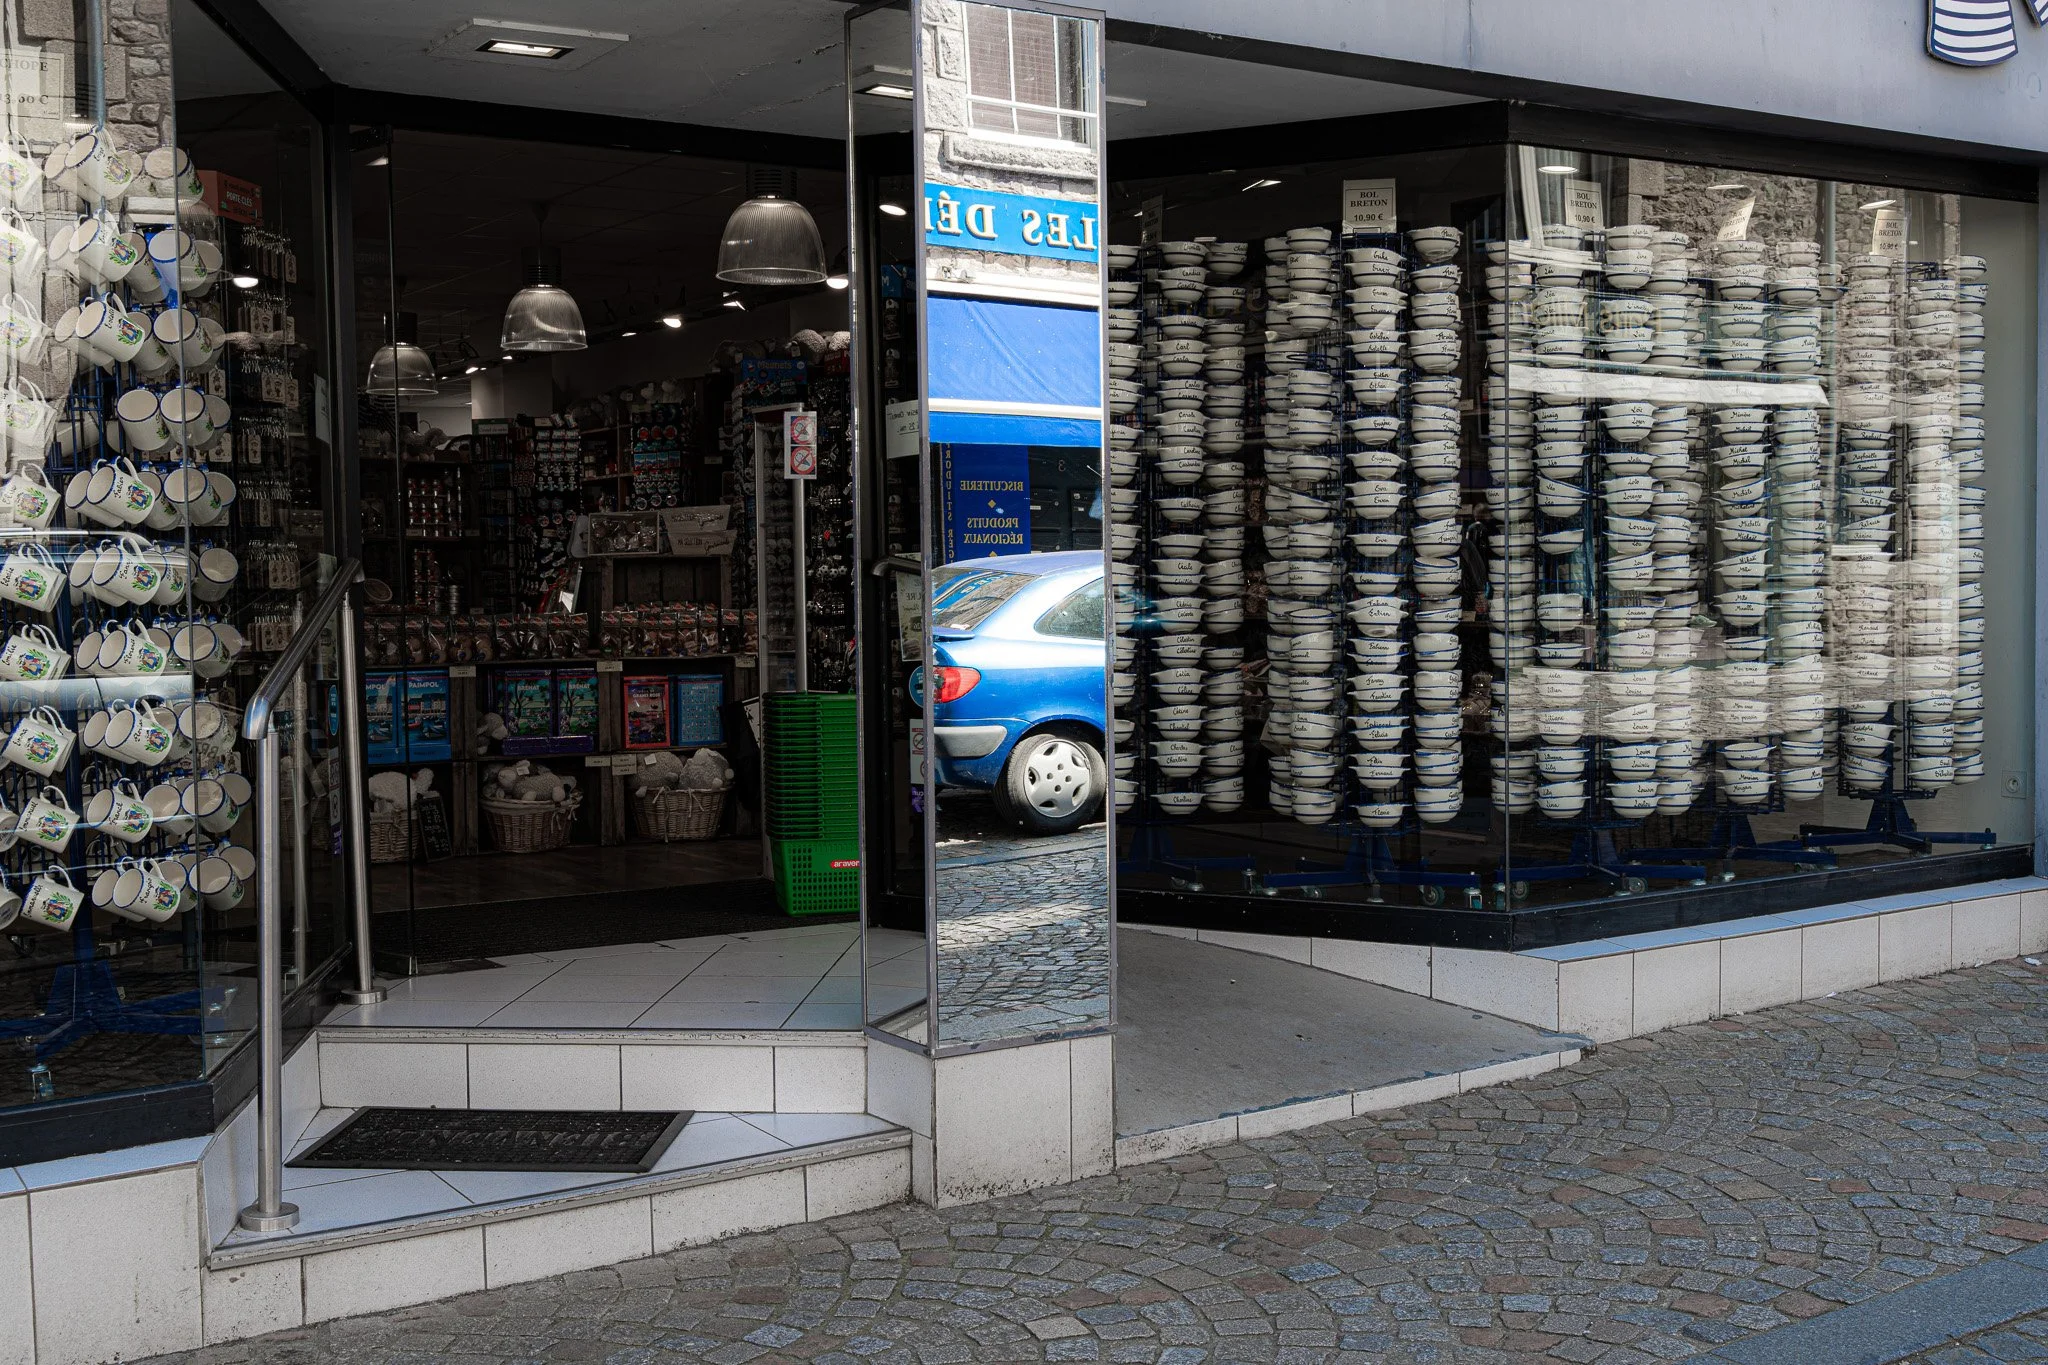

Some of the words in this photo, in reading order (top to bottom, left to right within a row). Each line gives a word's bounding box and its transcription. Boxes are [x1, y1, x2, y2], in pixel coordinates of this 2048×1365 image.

[1576, 192, 1590, 200] BOL
[1350, 199, 1388, 207] BRETON
[1570, 200, 1597, 209] BRETON
[1354, 214, 1376, 222] 10,90
[366, 683, 387, 691] MPOL
[408, 681, 440, 689] PAIMPOL
